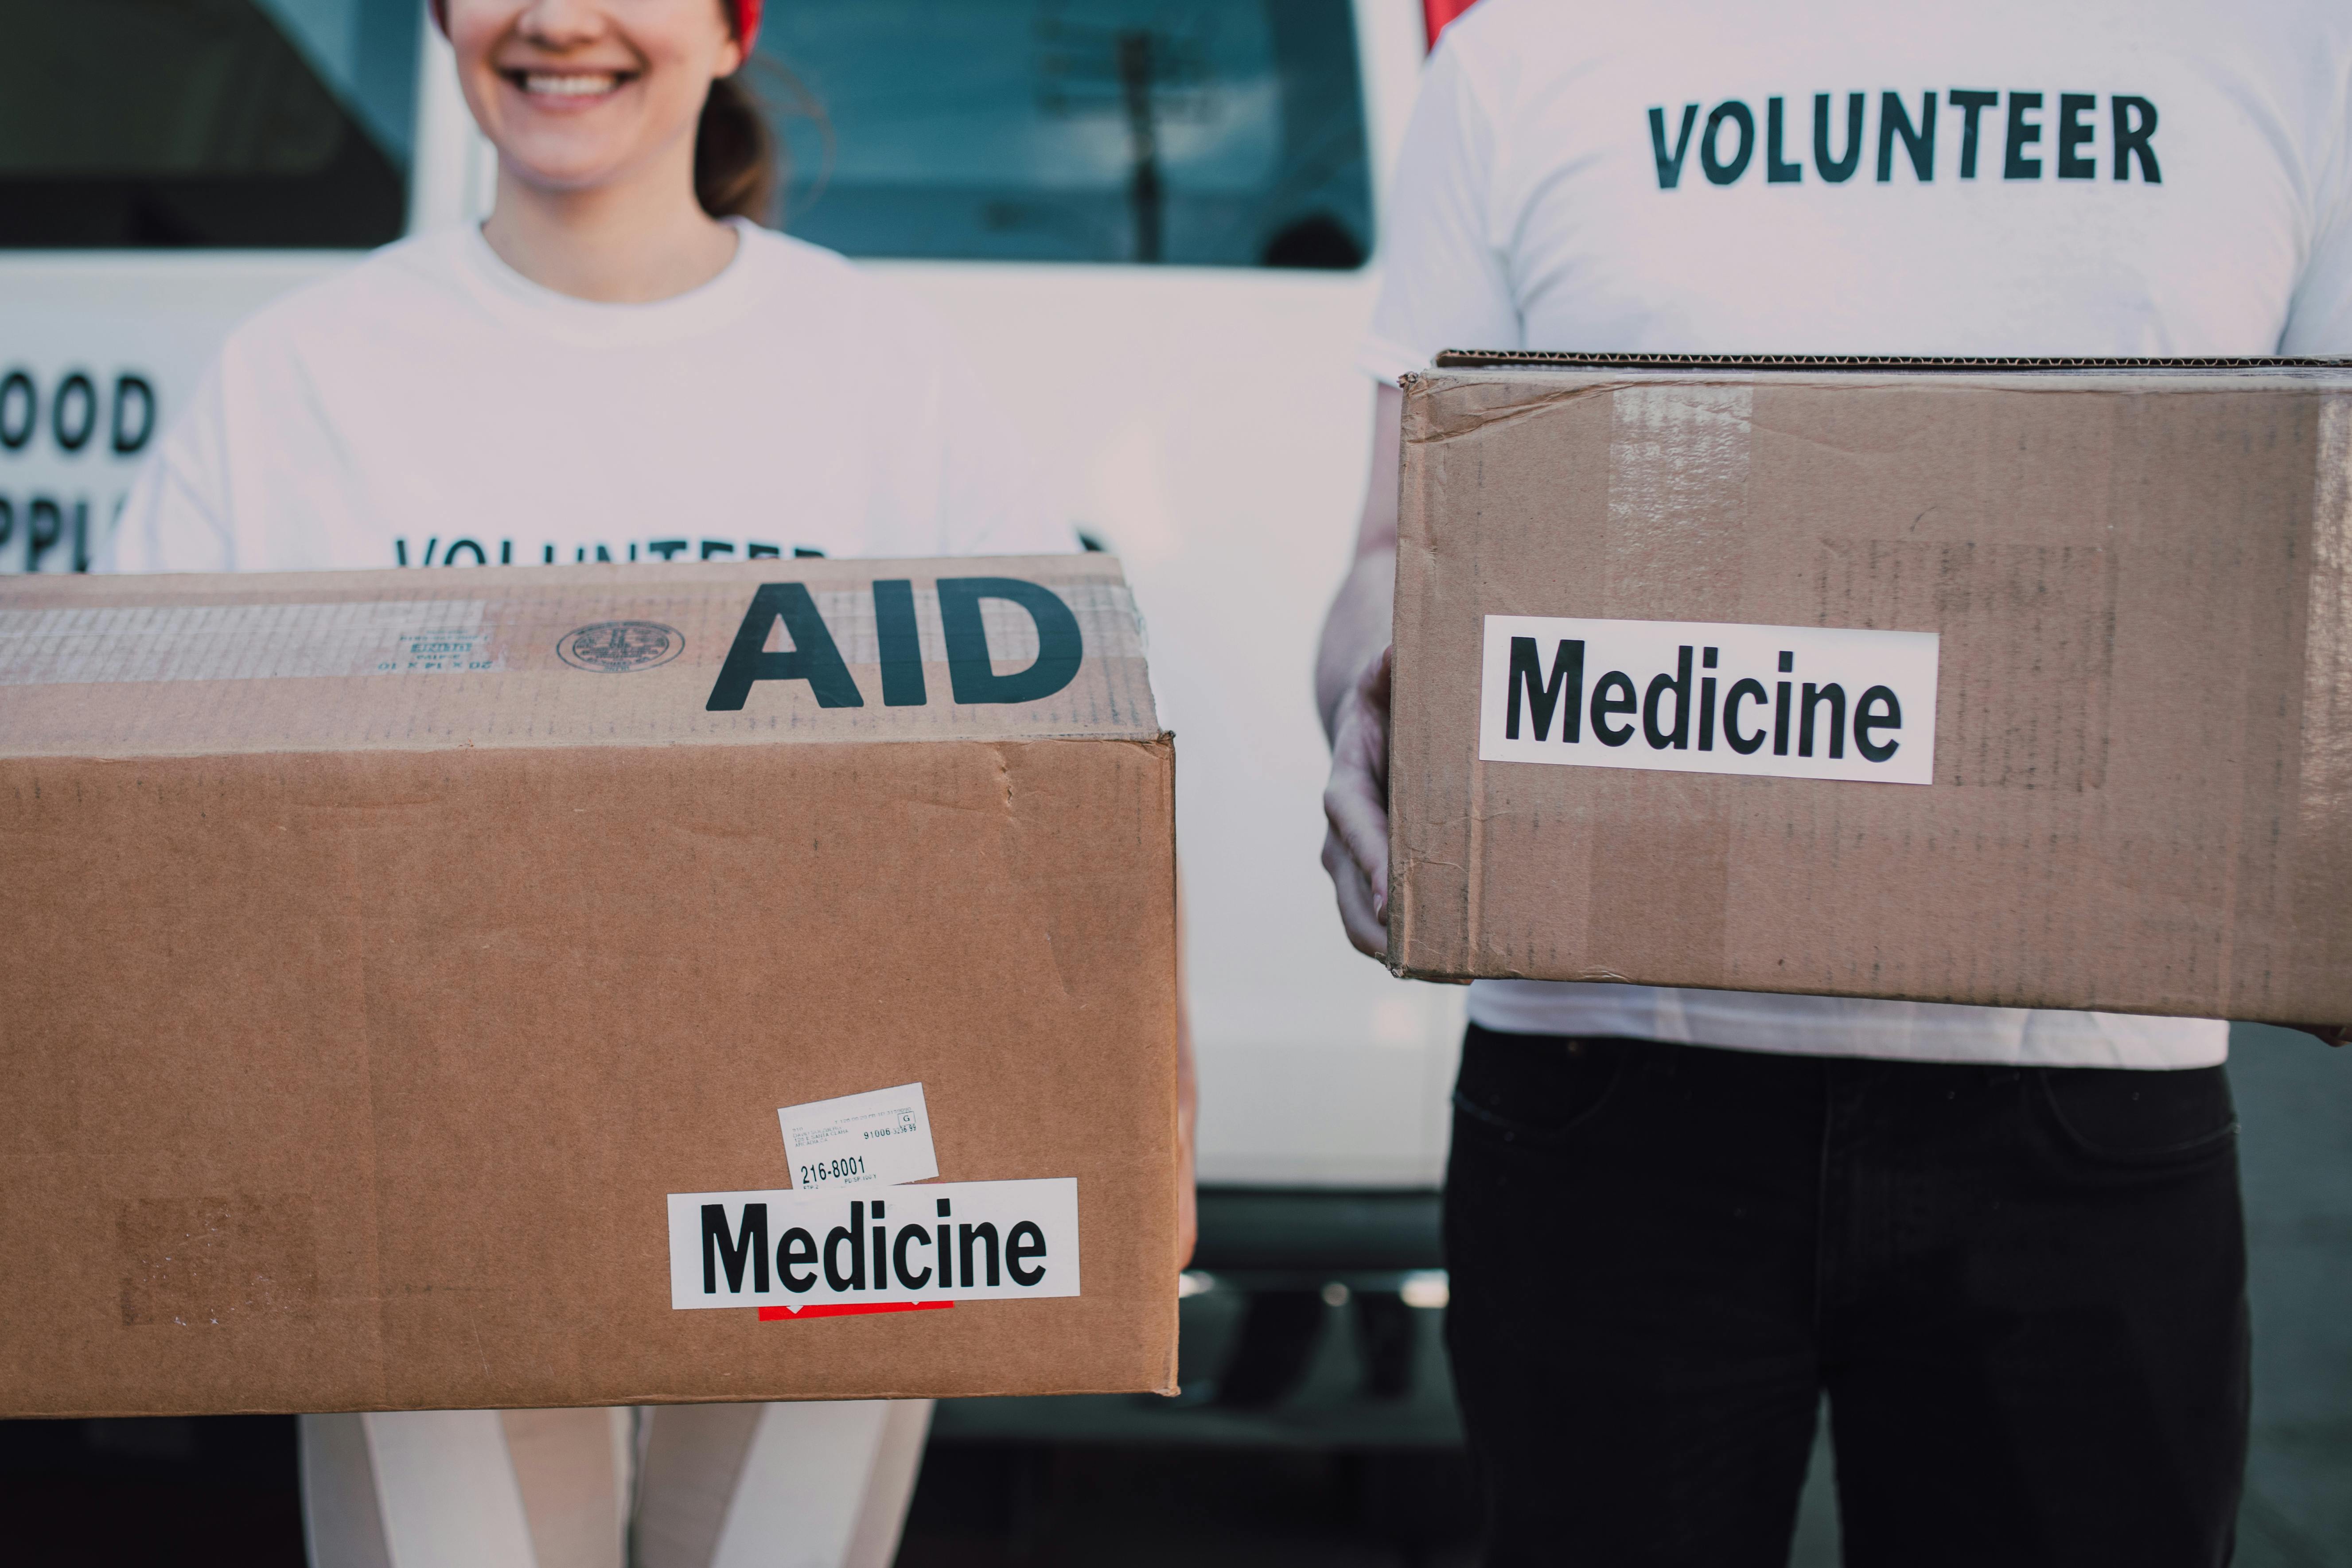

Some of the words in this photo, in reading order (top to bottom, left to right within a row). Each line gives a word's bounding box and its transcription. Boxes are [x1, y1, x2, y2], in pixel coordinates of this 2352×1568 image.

[1648, 89, 2162, 189] VOLUNTEER
[0, 369, 157, 457] OOD
[705, 577, 1083, 712] AID
[1506, 636, 1902, 763] Medicine
[801, 1155, 865, 1184] 216-8001
[701, 1198, 1047, 1293] Medicine
